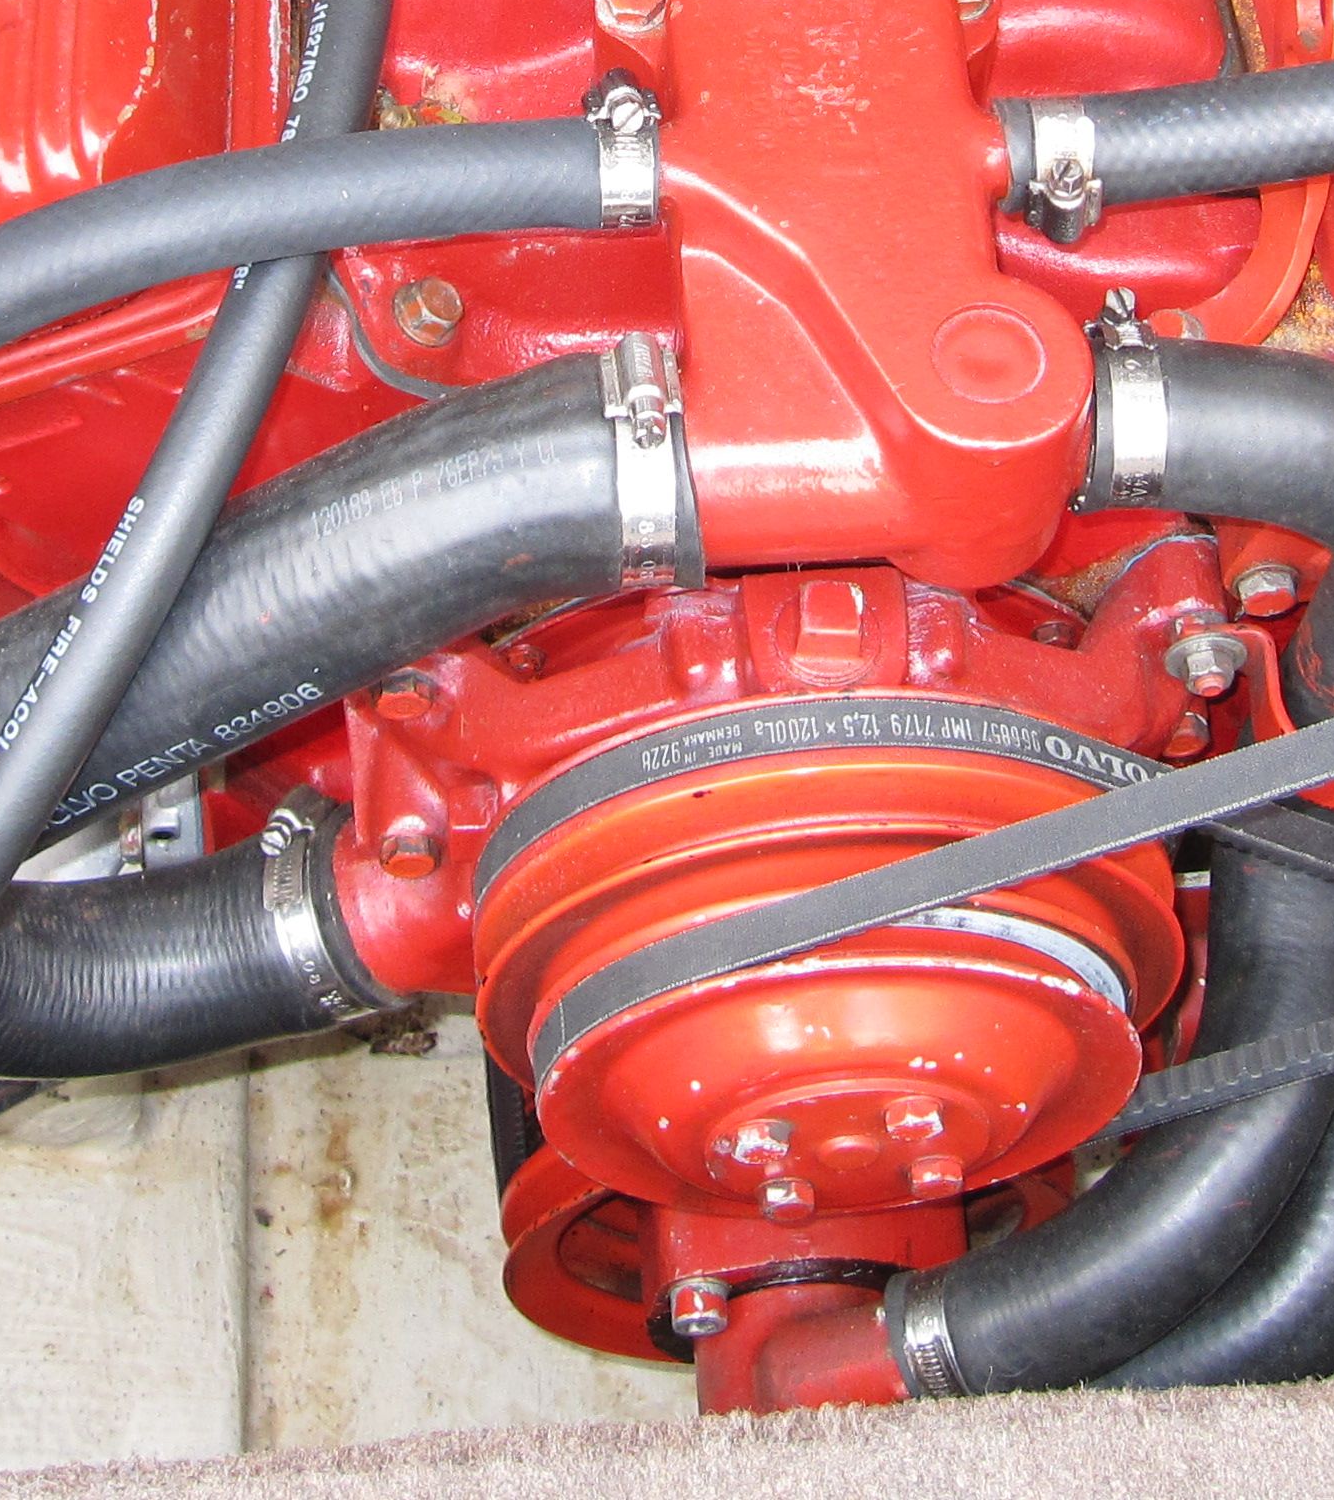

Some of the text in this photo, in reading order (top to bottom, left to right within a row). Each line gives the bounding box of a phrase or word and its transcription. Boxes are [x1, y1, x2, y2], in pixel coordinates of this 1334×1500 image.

[81, 495, 146, 604] SHIELDS
[116, 737, 214, 788] PENTA
[213, 681, 325, 742] 834906
[681, 723, 741, 747] DENMARK
[890, 712, 935, 743] 7179
[940, 714, 973, 741] IMP
[683, 740, 744, 765] MADE IN
[1044, 734, 1170, 786] OLVO
